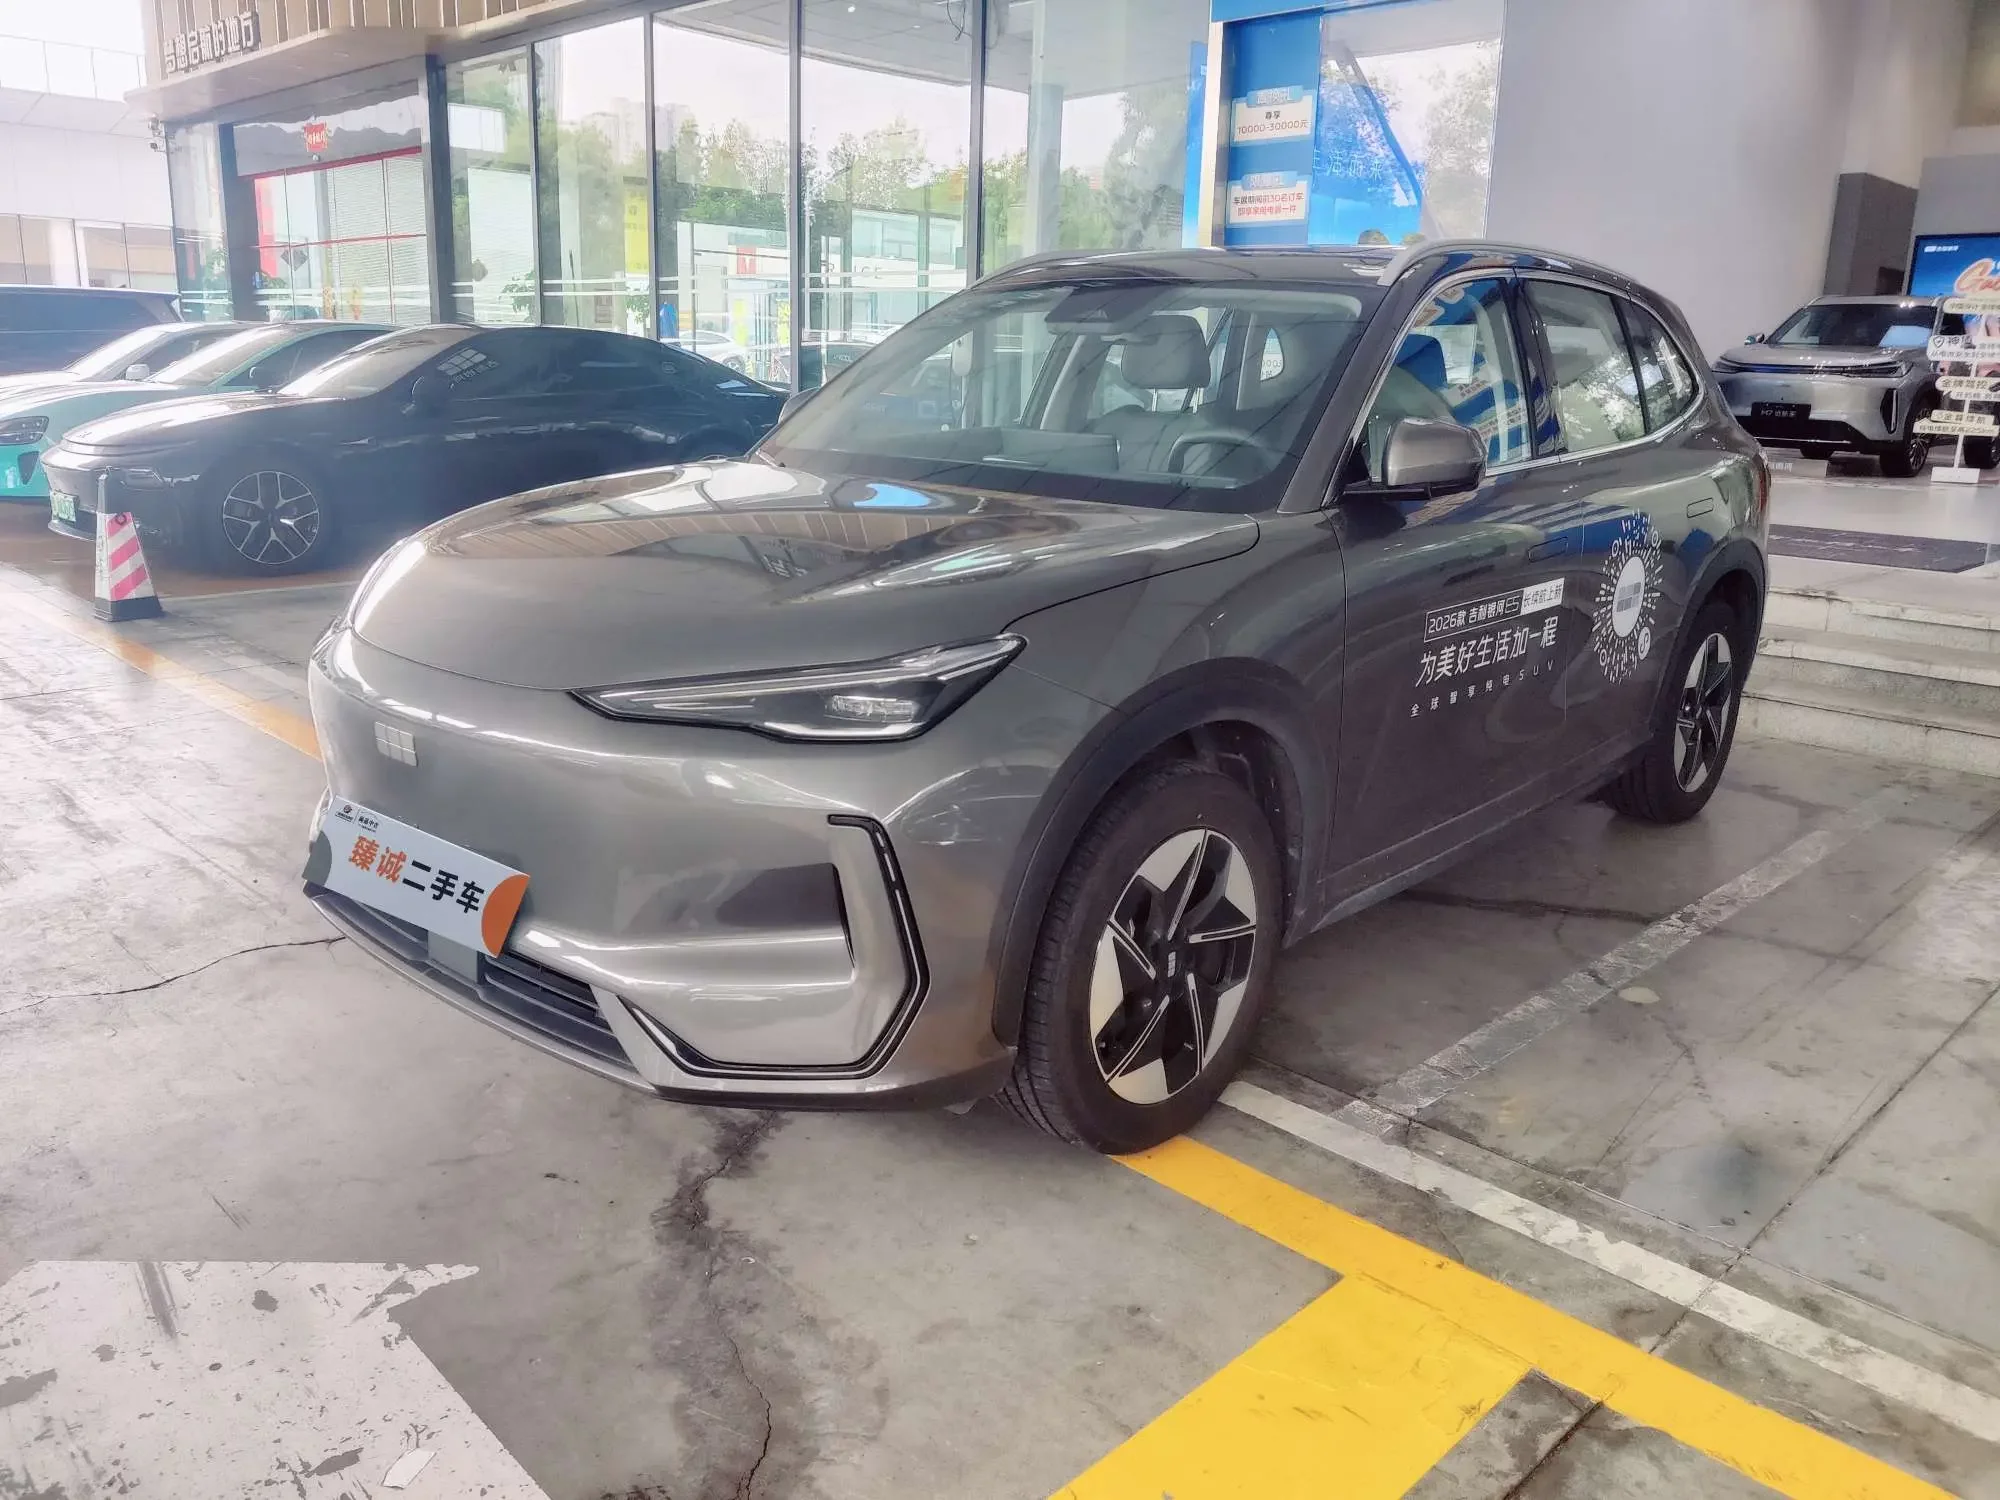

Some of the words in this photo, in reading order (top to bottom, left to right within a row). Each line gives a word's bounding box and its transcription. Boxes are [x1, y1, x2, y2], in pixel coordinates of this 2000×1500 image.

[1415, 615, 1559, 688] 为美好生活加一程
[1428, 610, 1467, 634] 2026款
[348, 835, 485, 914] 臻诚二手车
